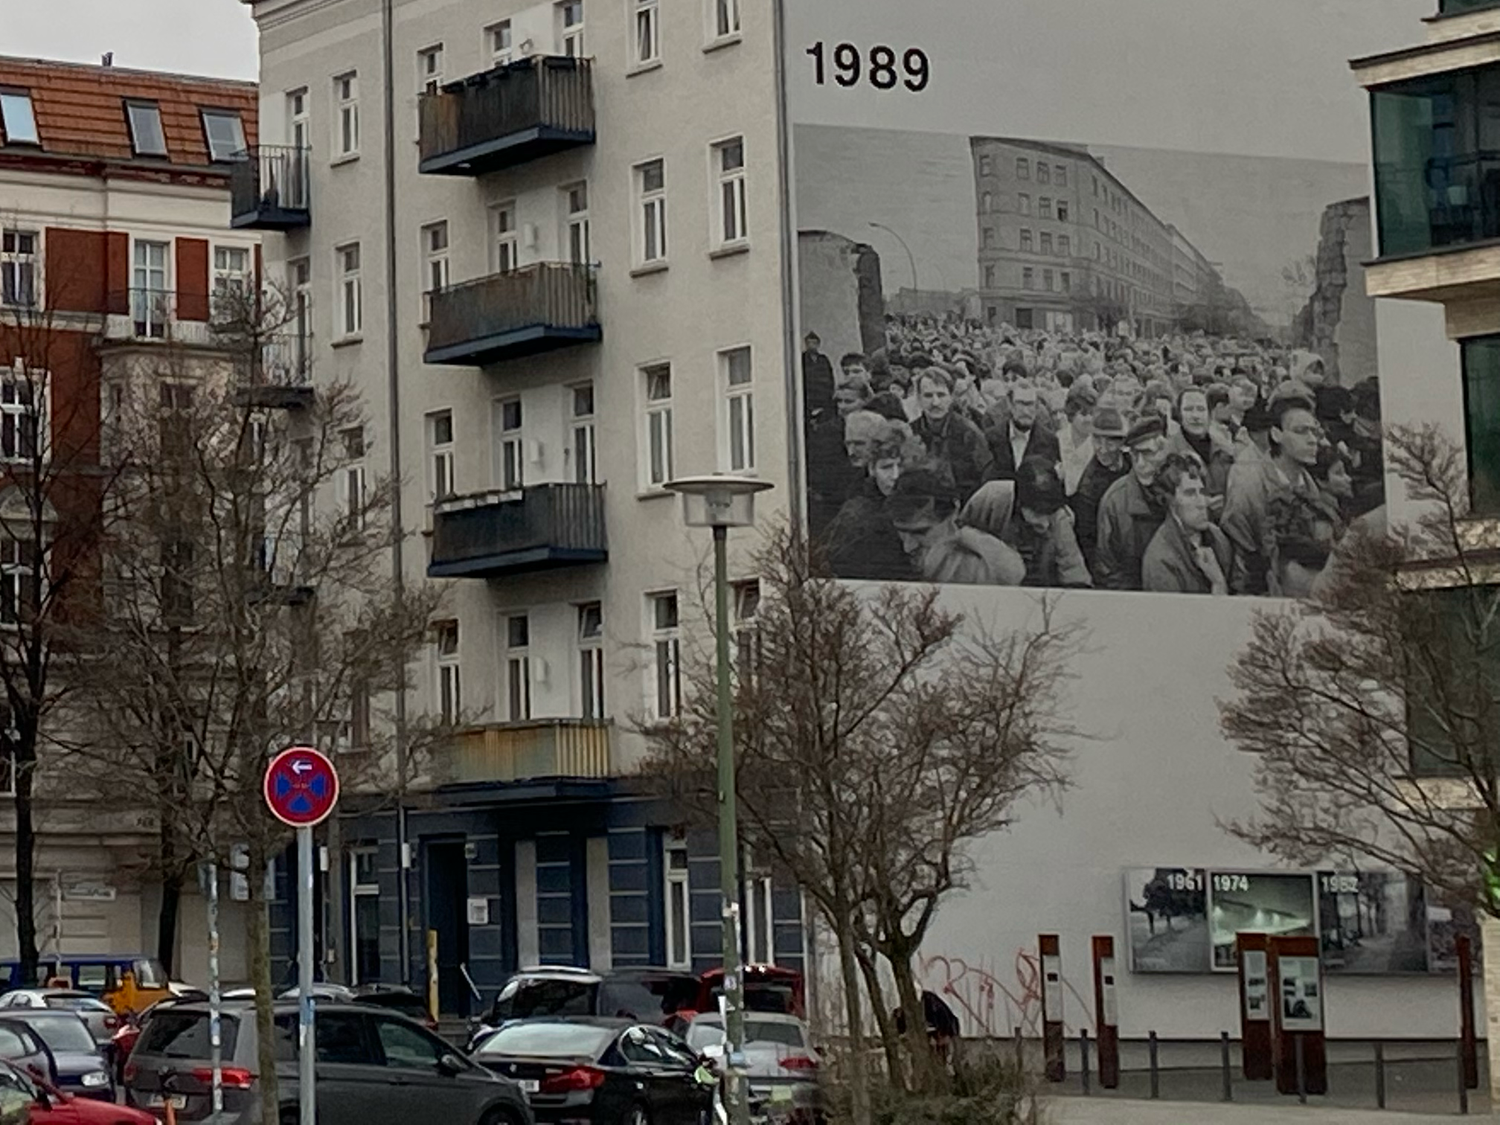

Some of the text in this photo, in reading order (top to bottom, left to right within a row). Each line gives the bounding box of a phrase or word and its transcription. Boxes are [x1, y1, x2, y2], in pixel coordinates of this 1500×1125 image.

[805, 41, 930, 92] 1989
[1167, 874, 1203, 891] 1961
[1213, 875, 1249, 891] 1974
